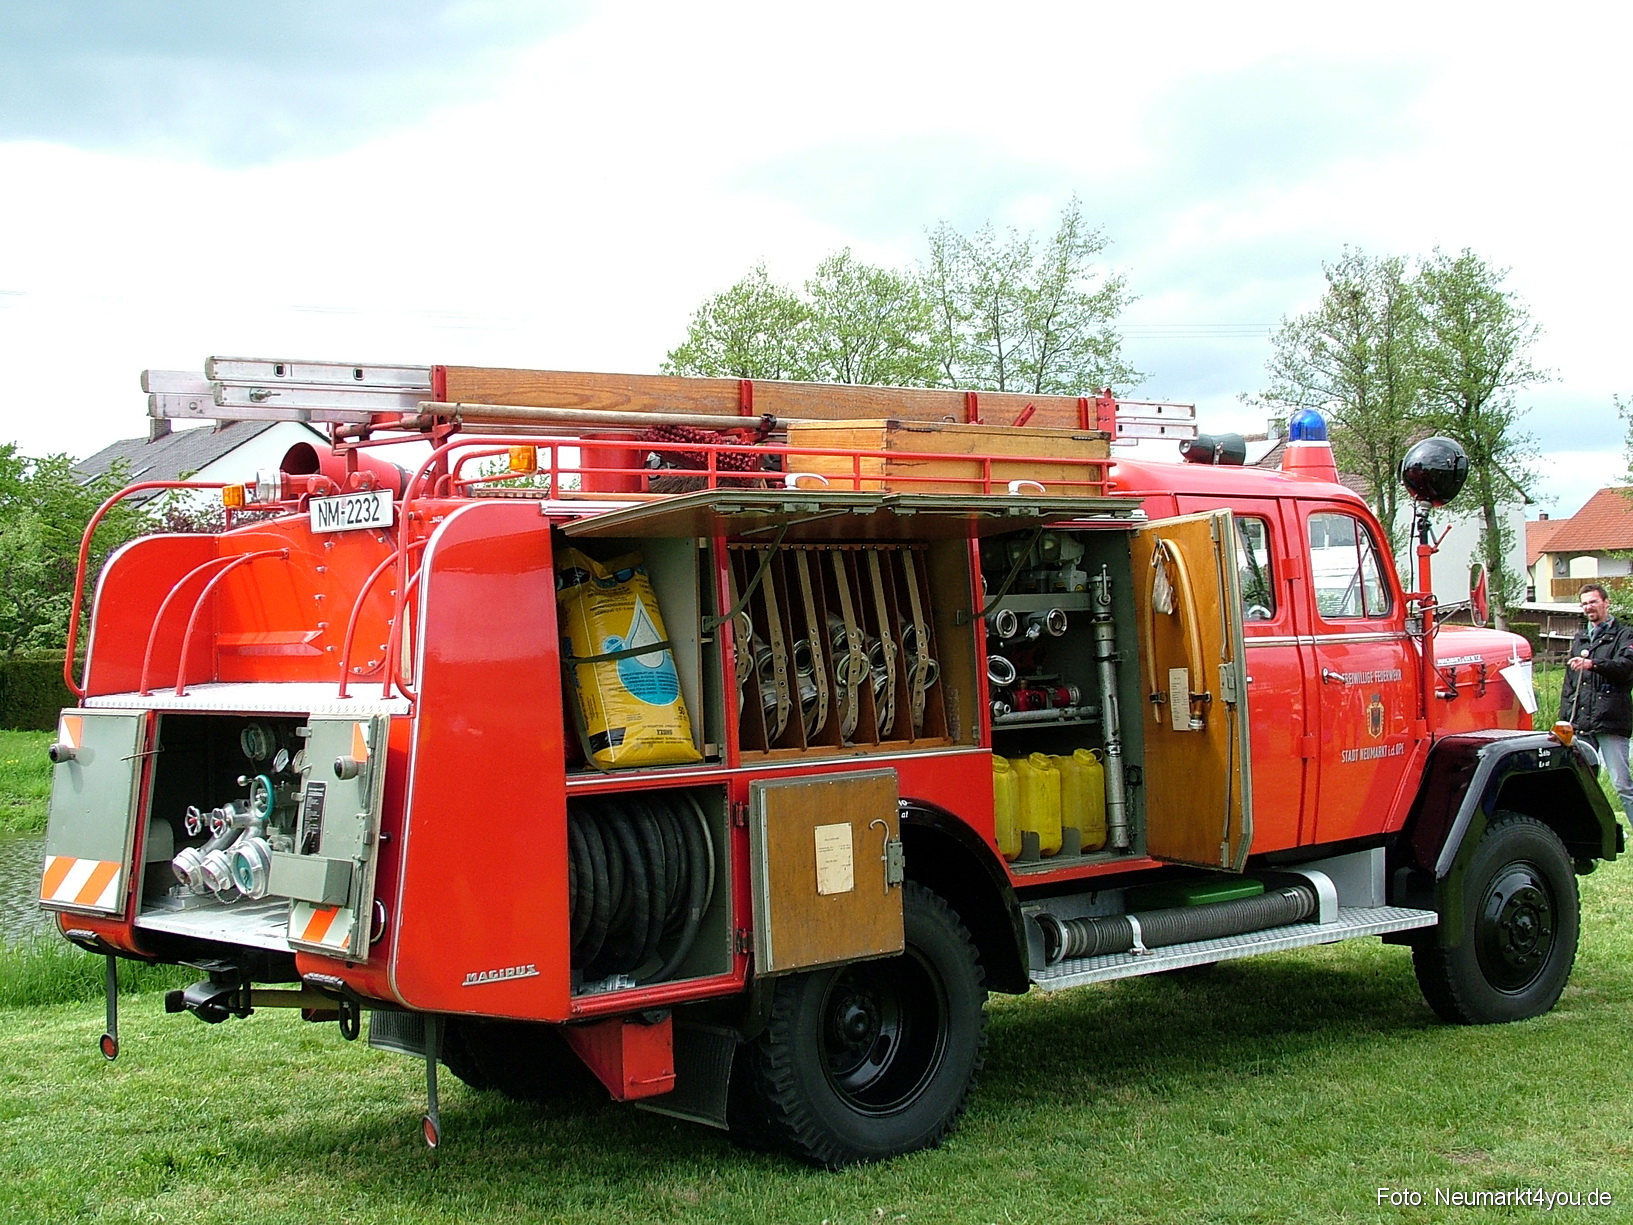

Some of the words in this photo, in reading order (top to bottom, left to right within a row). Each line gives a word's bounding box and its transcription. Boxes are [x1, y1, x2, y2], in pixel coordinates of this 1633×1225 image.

[317, 497, 380, 528] NM-2232
[1375, 669, 1402, 683] FEUERWEHR
[1342, 749, 1358, 763] STADT
[1360, 744, 1388, 761] NEUMARKT
[464, 964, 537, 984] MAGIRUS
